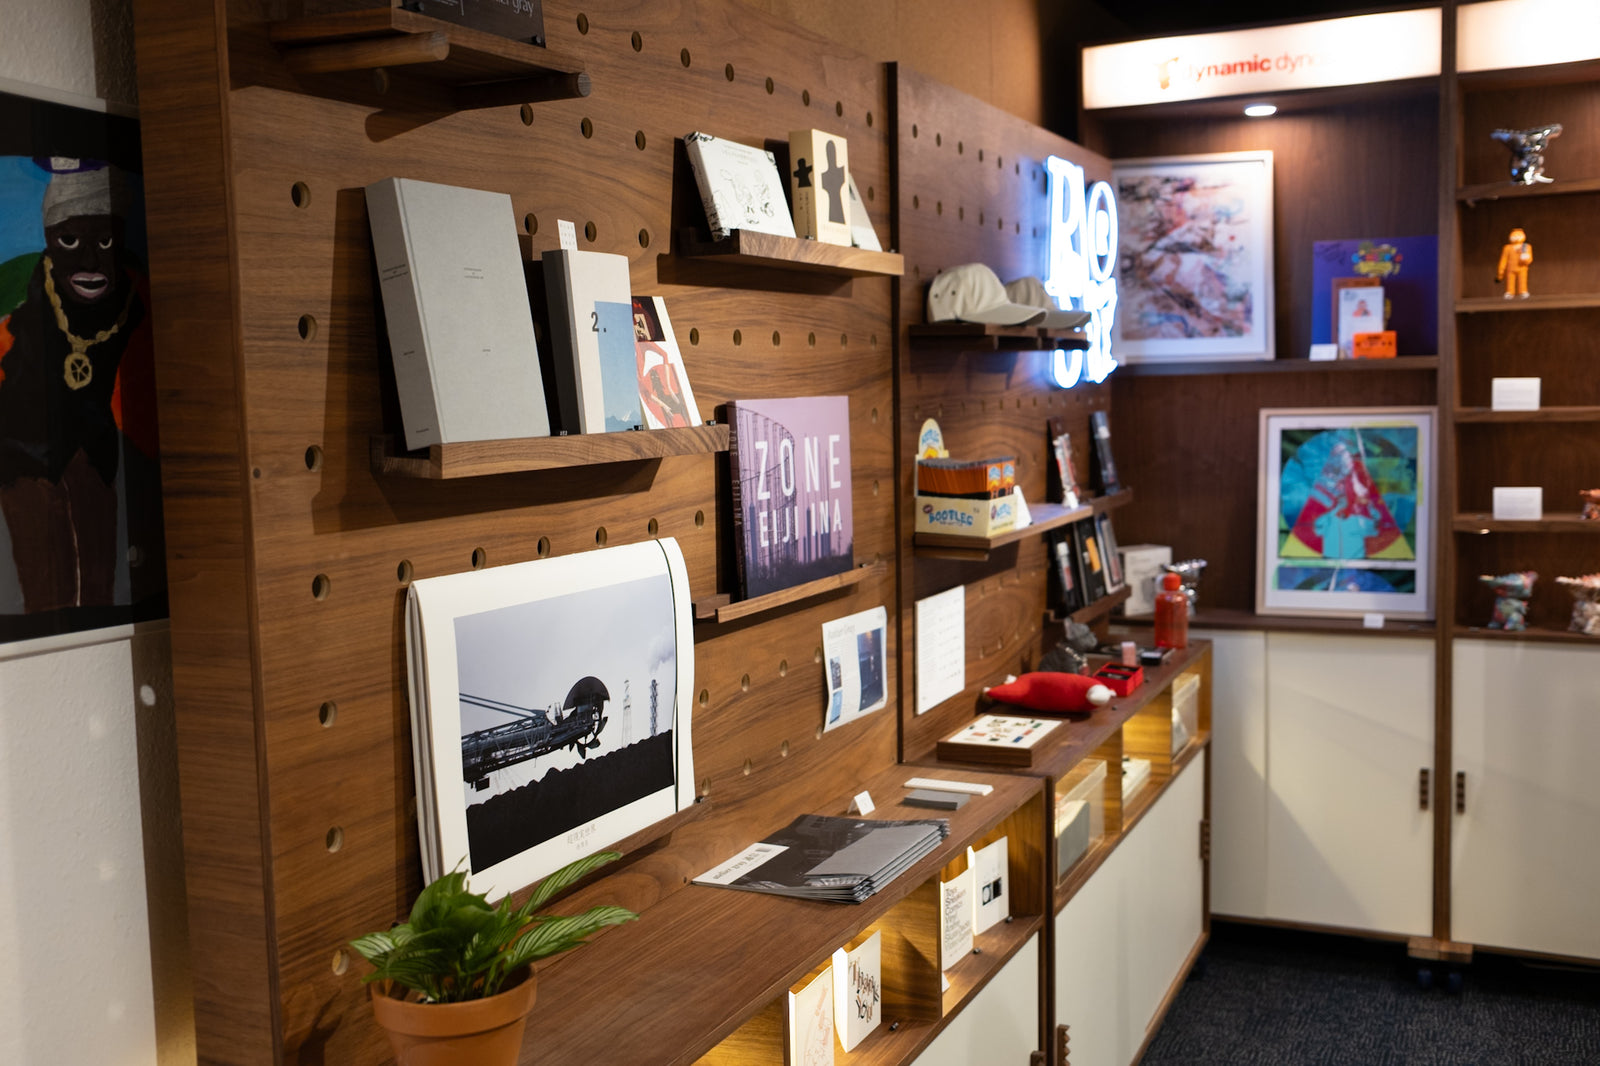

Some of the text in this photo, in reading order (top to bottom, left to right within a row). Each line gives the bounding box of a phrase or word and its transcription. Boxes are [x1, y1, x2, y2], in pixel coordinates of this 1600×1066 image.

[590, 310, 608, 333] 2.
[755, 434, 842, 501] ZONE
[758, 498, 843, 548] EIJI INA
